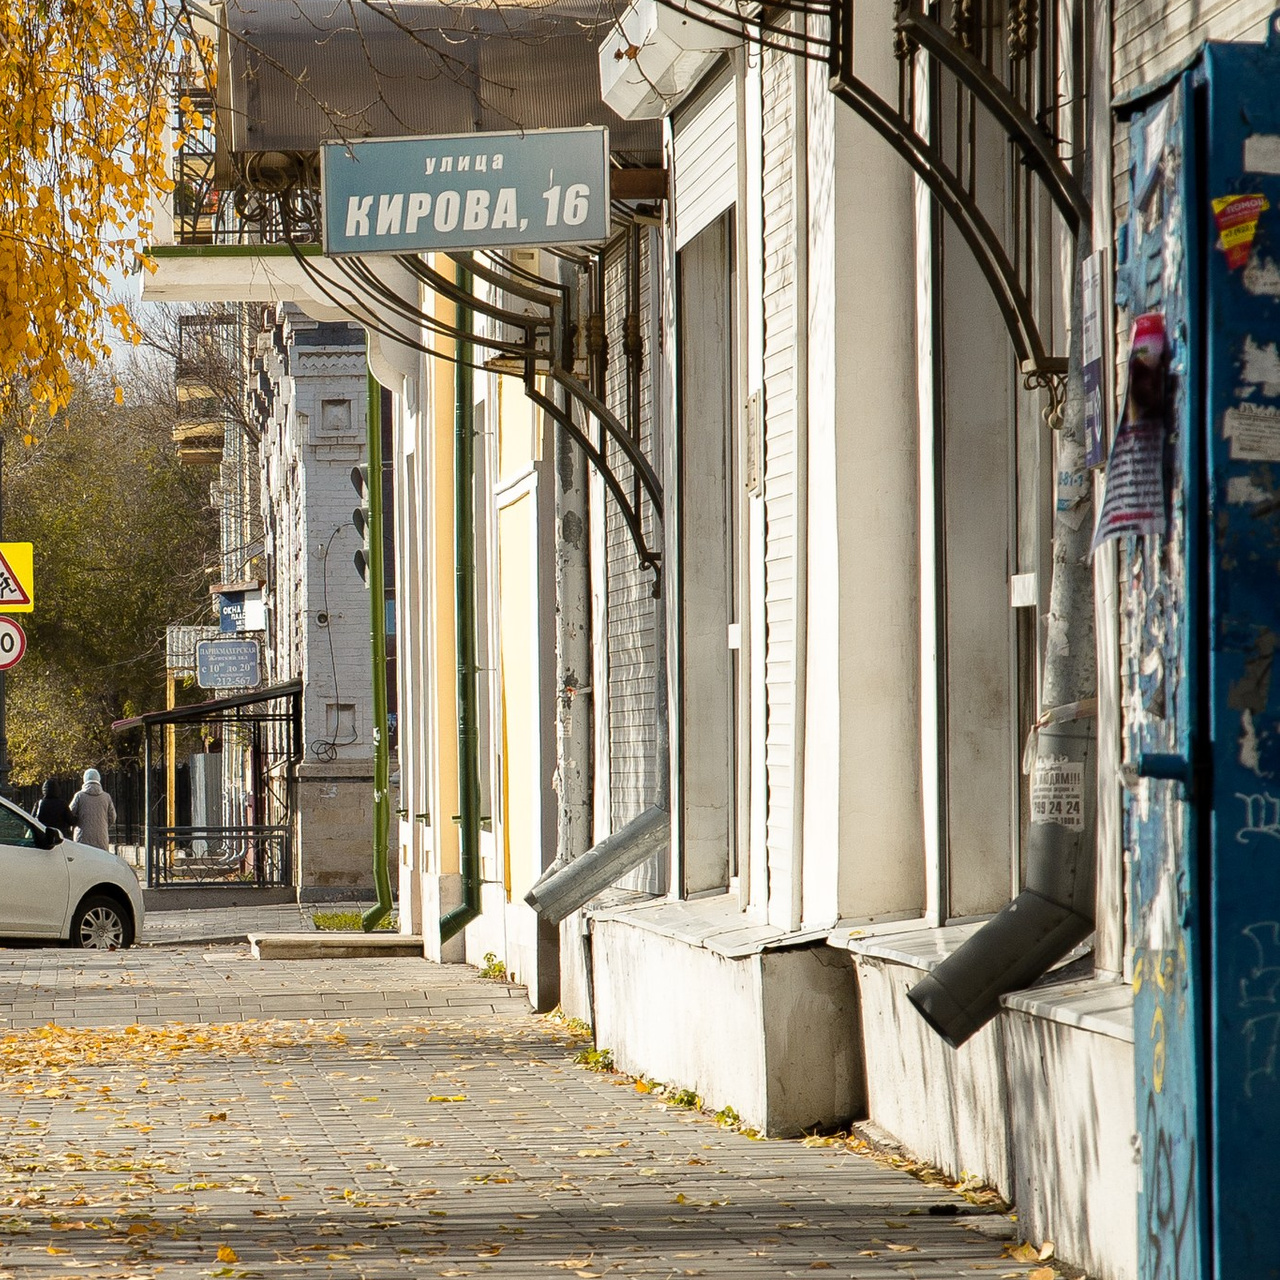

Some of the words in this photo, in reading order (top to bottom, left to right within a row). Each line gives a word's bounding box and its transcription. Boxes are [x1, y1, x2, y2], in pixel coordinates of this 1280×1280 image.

[425, 153, 504, 176] улица
[345, 187, 529, 237] КИРОВА,
[542, 183, 590, 227] 16
[223, 606, 241, 614] ОКНА
[200, 647, 256, 655] ПАРИКМАХЕРСКАЯ
[226, 665, 238, 673] до
[216, 677, 251, 686] 212-567
[1049, 801, 1062, 815] 24
[1066, 801, 1080, 815] 24
